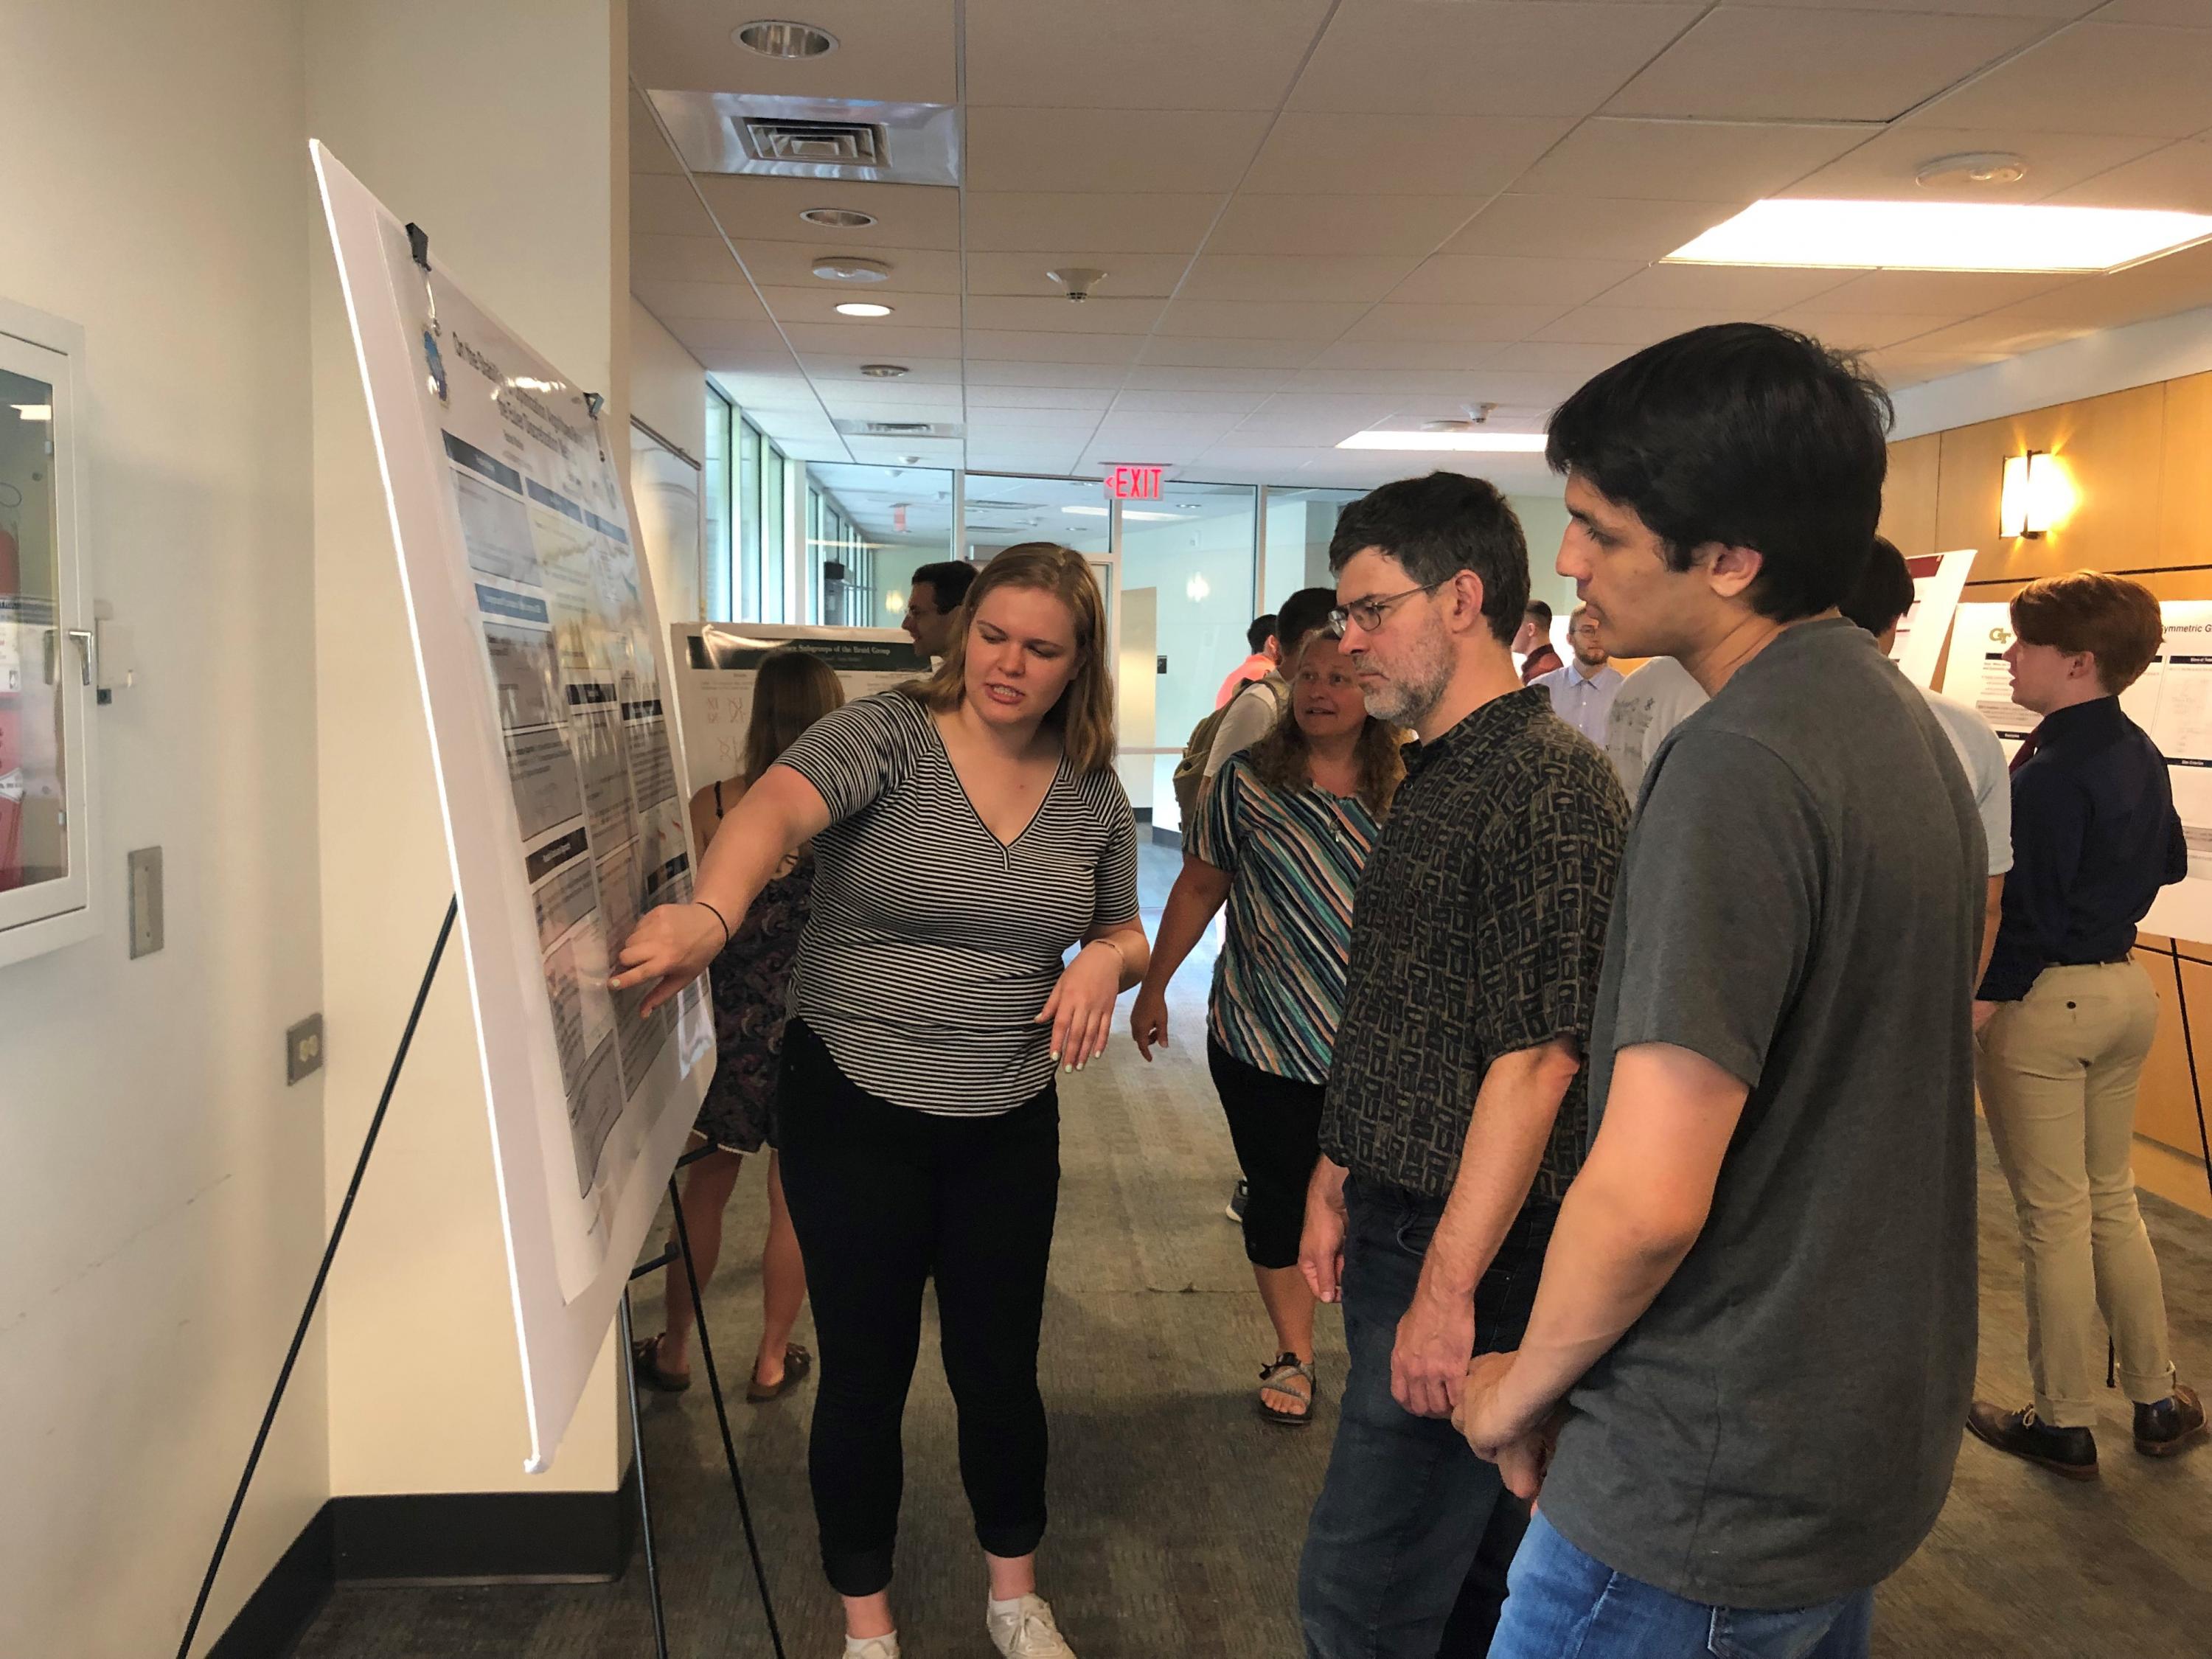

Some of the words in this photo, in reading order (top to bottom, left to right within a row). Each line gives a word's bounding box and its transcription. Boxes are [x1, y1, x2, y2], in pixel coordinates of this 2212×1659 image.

[1116, 467, 1162, 498] EXIT
[2162, 625, 2202, 634] ymmetric
[799, 644, 832, 653] Subgroups
[872, 647, 891, 655] Group
